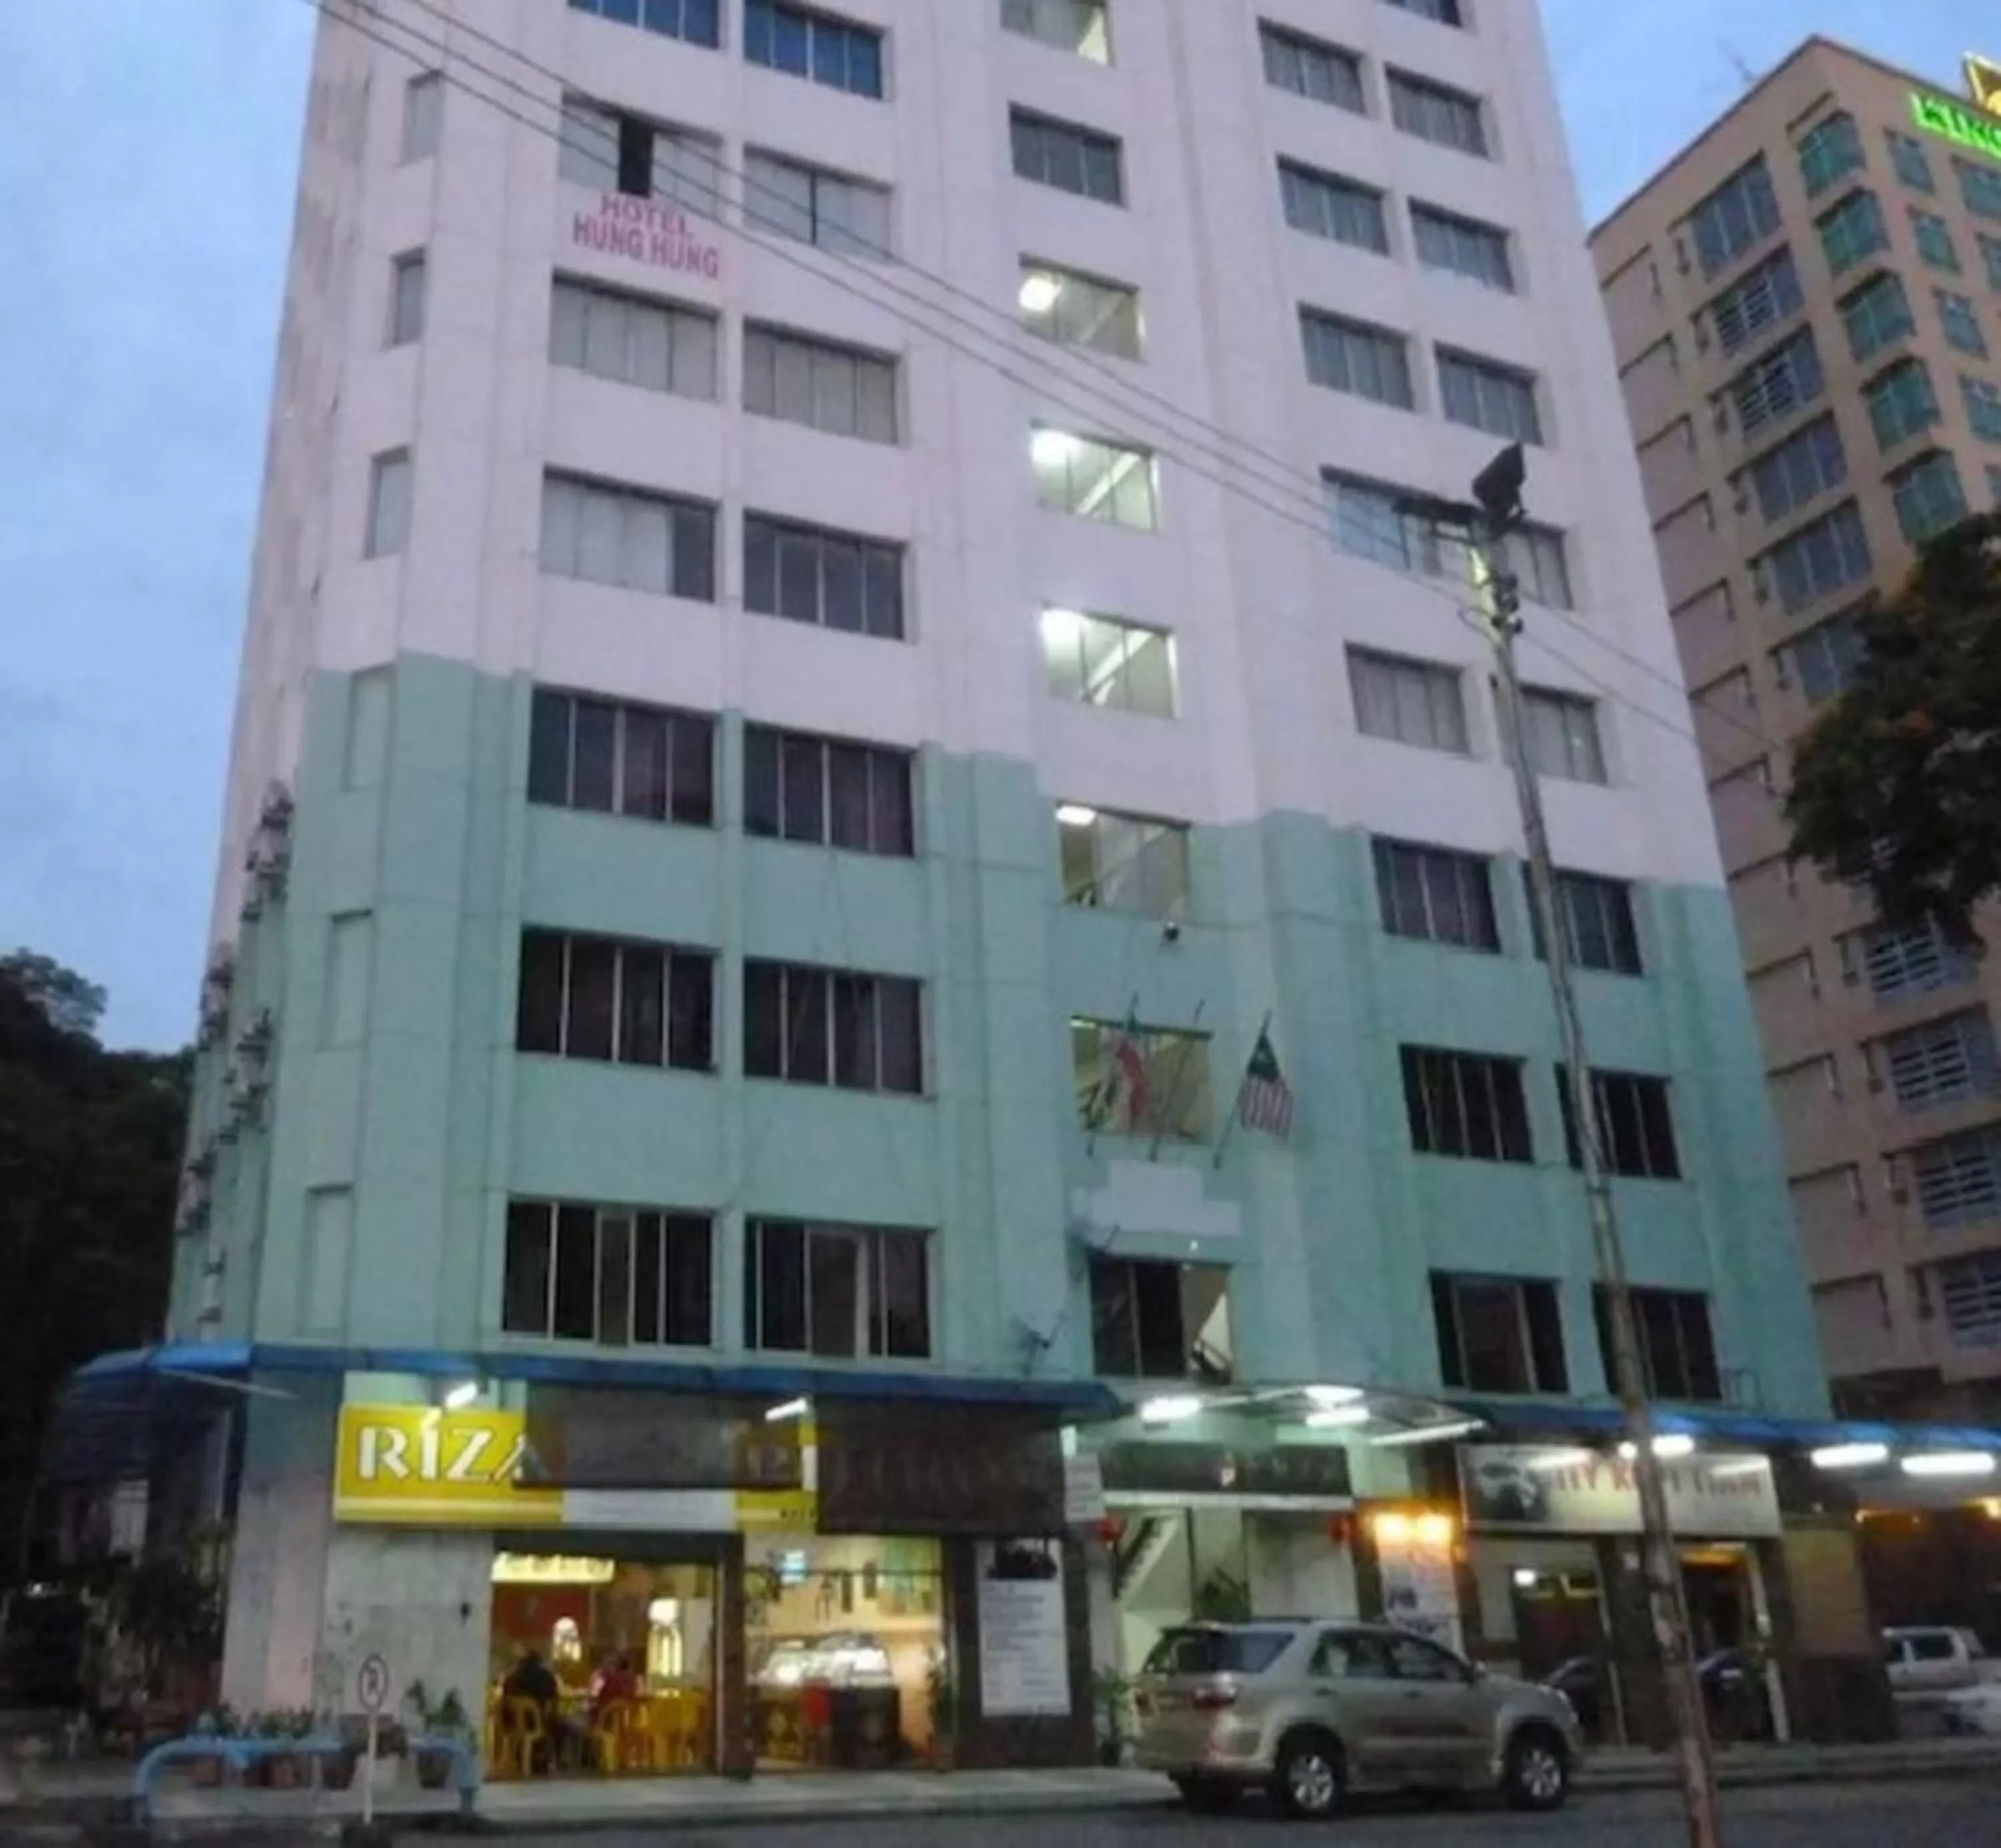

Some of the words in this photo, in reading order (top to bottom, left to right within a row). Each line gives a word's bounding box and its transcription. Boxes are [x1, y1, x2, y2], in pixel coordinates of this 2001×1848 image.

[602, 193, 694, 238] HOTEL
[573, 211, 644, 259] HUNG
[649, 234, 719, 278] HUNG
